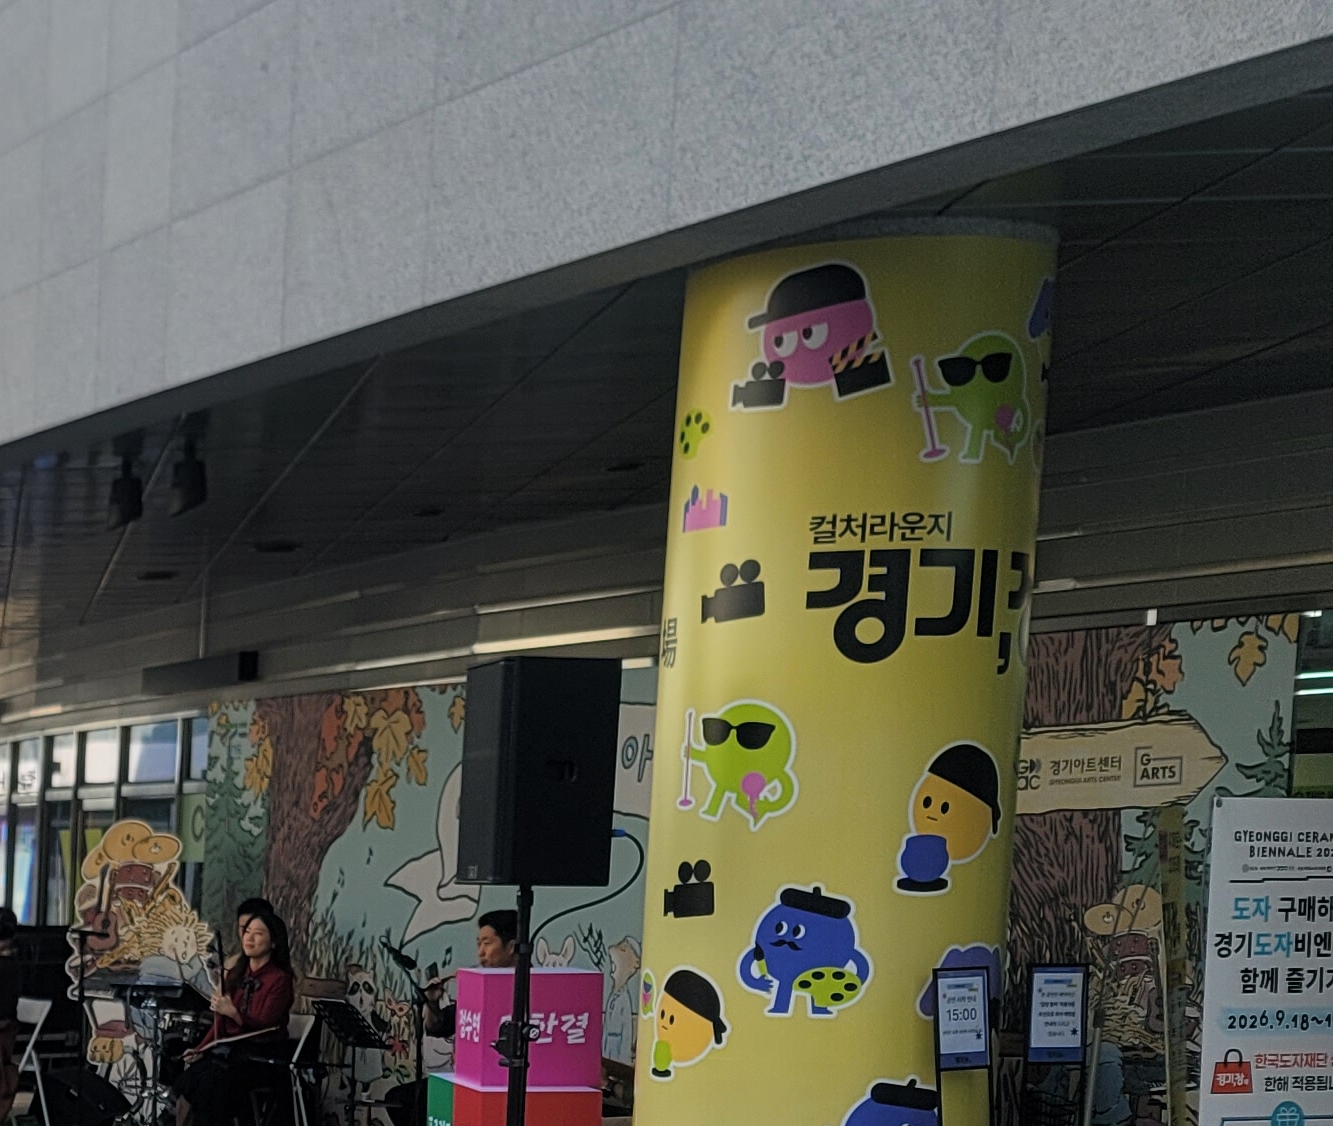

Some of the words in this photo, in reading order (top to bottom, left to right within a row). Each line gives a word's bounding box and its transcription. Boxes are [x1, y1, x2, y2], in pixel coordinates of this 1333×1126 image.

[808, 511, 953, 544] 컬처라운지
[1049, 755, 1122, 776] 경기아트센터
[1140, 753, 1151, 766] G
[1140, 766, 1176, 780] ARTS
[1234, 829, 1292, 843] GYEONGGI
[1297, 830, 1333, 844] CERA
[1249, 845, 1312, 858] BIENNALE
[1231, 895, 1271, 922] 도자
[1214, 931, 1332, 958] 경기도자비엔
[1240, 967, 1279, 994] 함께
[946, 1007, 977, 1022] 15:00
[499, 1012, 589, 1044] 한결
[1254, 1053, 1328, 1070] 한국도자재단
[1264, 1076, 1289, 1092] 한해
